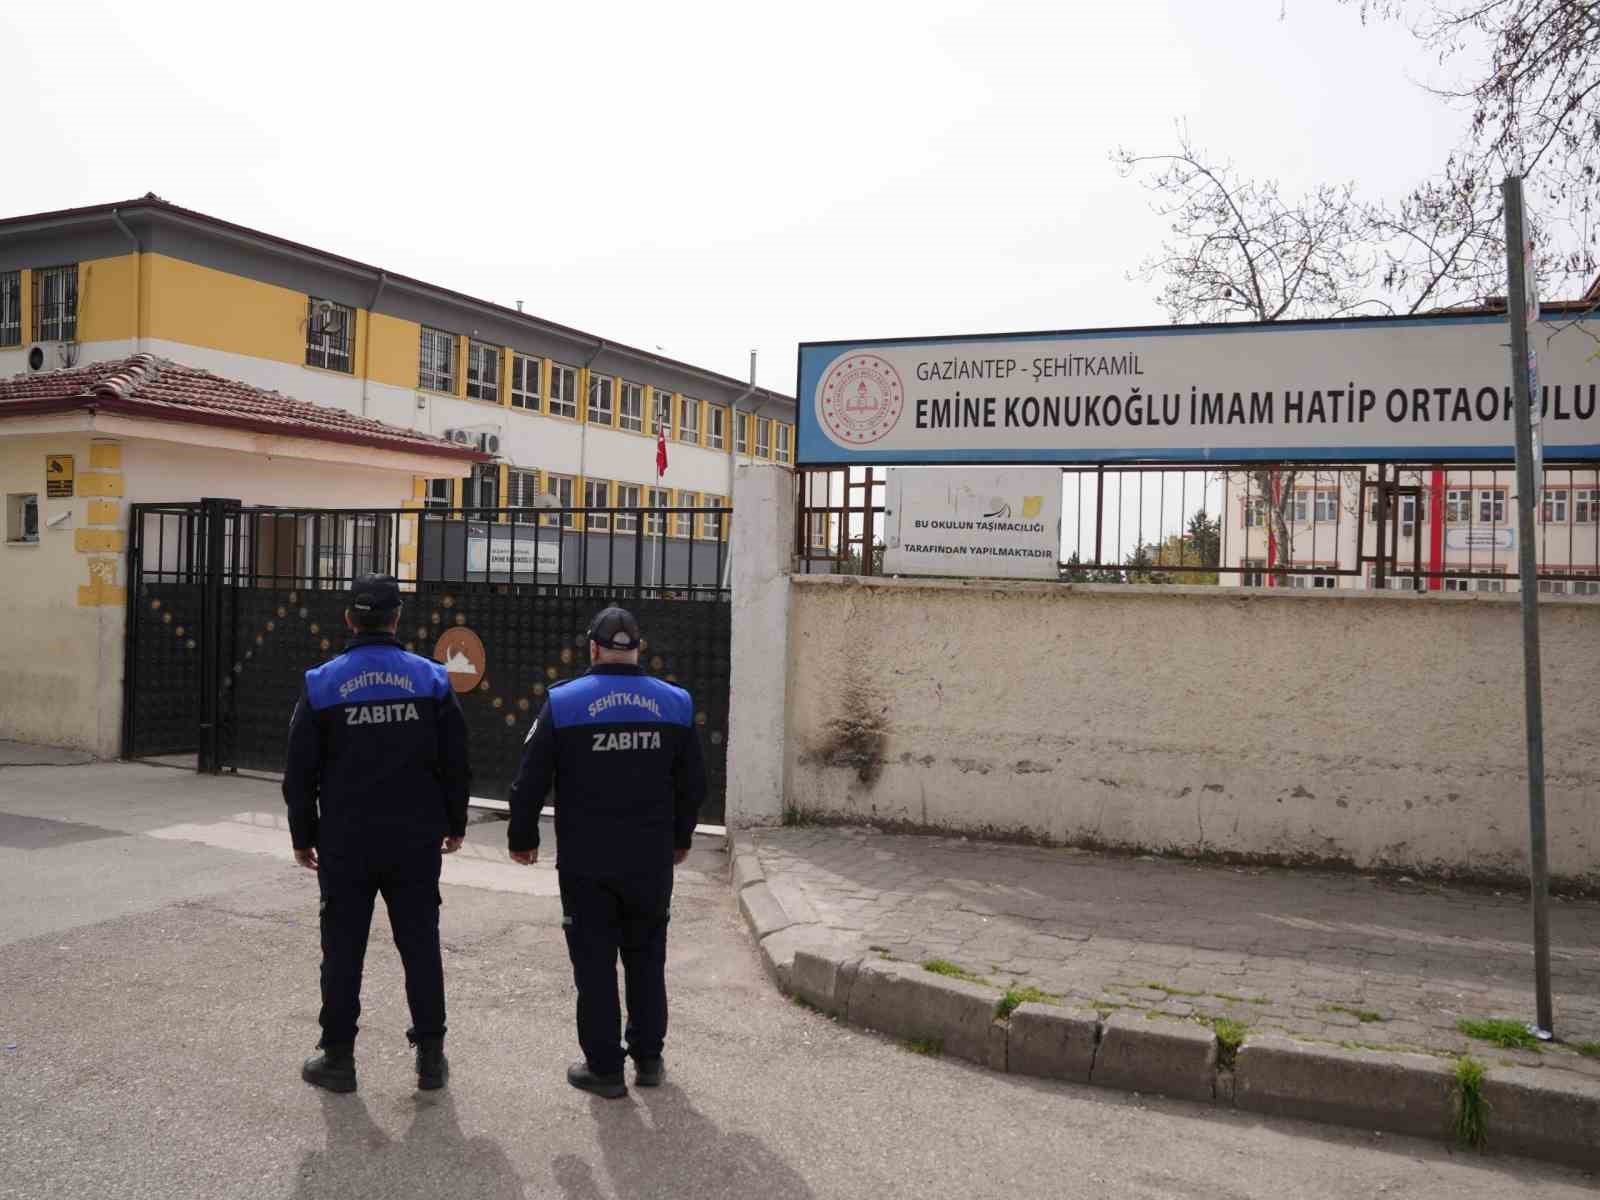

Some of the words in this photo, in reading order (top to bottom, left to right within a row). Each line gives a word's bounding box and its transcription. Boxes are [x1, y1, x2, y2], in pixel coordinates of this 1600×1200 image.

[916, 356, 1017, 381] GAZİANTEP
[1032, 352, 1144, 383] ŞEHİTKAMİL
[915, 391, 996, 429] EMİNE
[1004, 386, 1181, 428] KONUKOĞLU
[1190, 385, 1274, 425] İMAM
[1284, 381, 1377, 424] HATİP
[914, 520, 929, 529] BU
[931, 520, 974, 530] OKULUN
[975, 522, 1045, 533] TAŞIMACILIĞI
[904, 544, 968, 555] TARAFINDAN
[969, 547, 1053, 558] YAPILMAKTADIR
[339, 670, 416, 699] ŞEHİTKAMİL
[344, 703, 420, 725] ZABITA
[587, 690, 662, 717] ŞEHİTKAMİL
[592, 731, 661, 752] ZABITA
